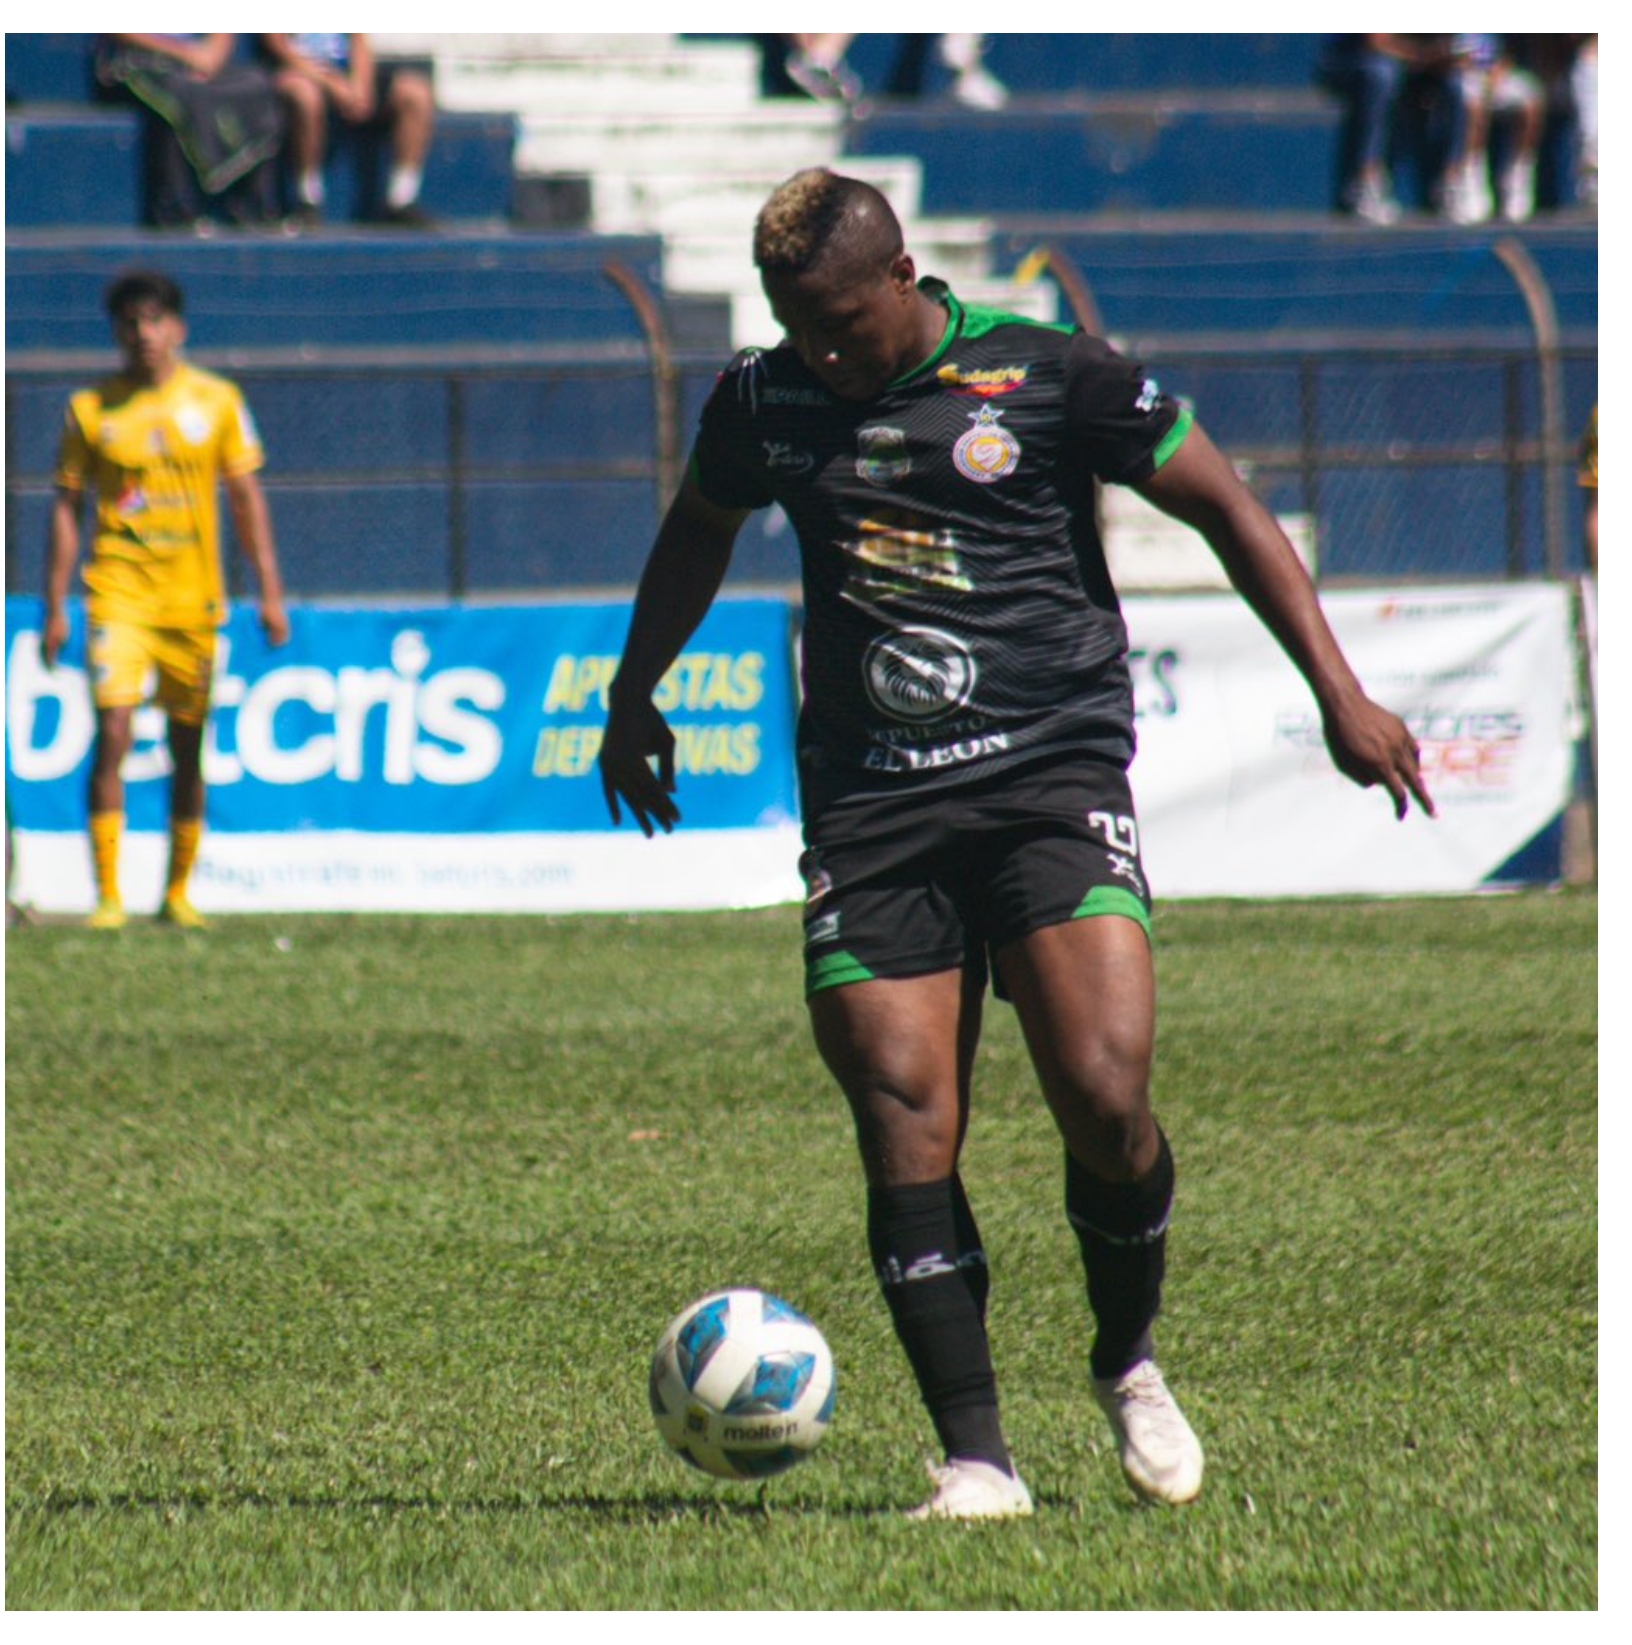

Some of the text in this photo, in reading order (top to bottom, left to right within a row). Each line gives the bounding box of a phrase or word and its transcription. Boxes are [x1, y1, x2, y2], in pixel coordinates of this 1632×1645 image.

[542, 653, 764, 713] APSTAS
[907, 731, 1011, 769] LEON
[723, 1421, 799, 1442] molten
